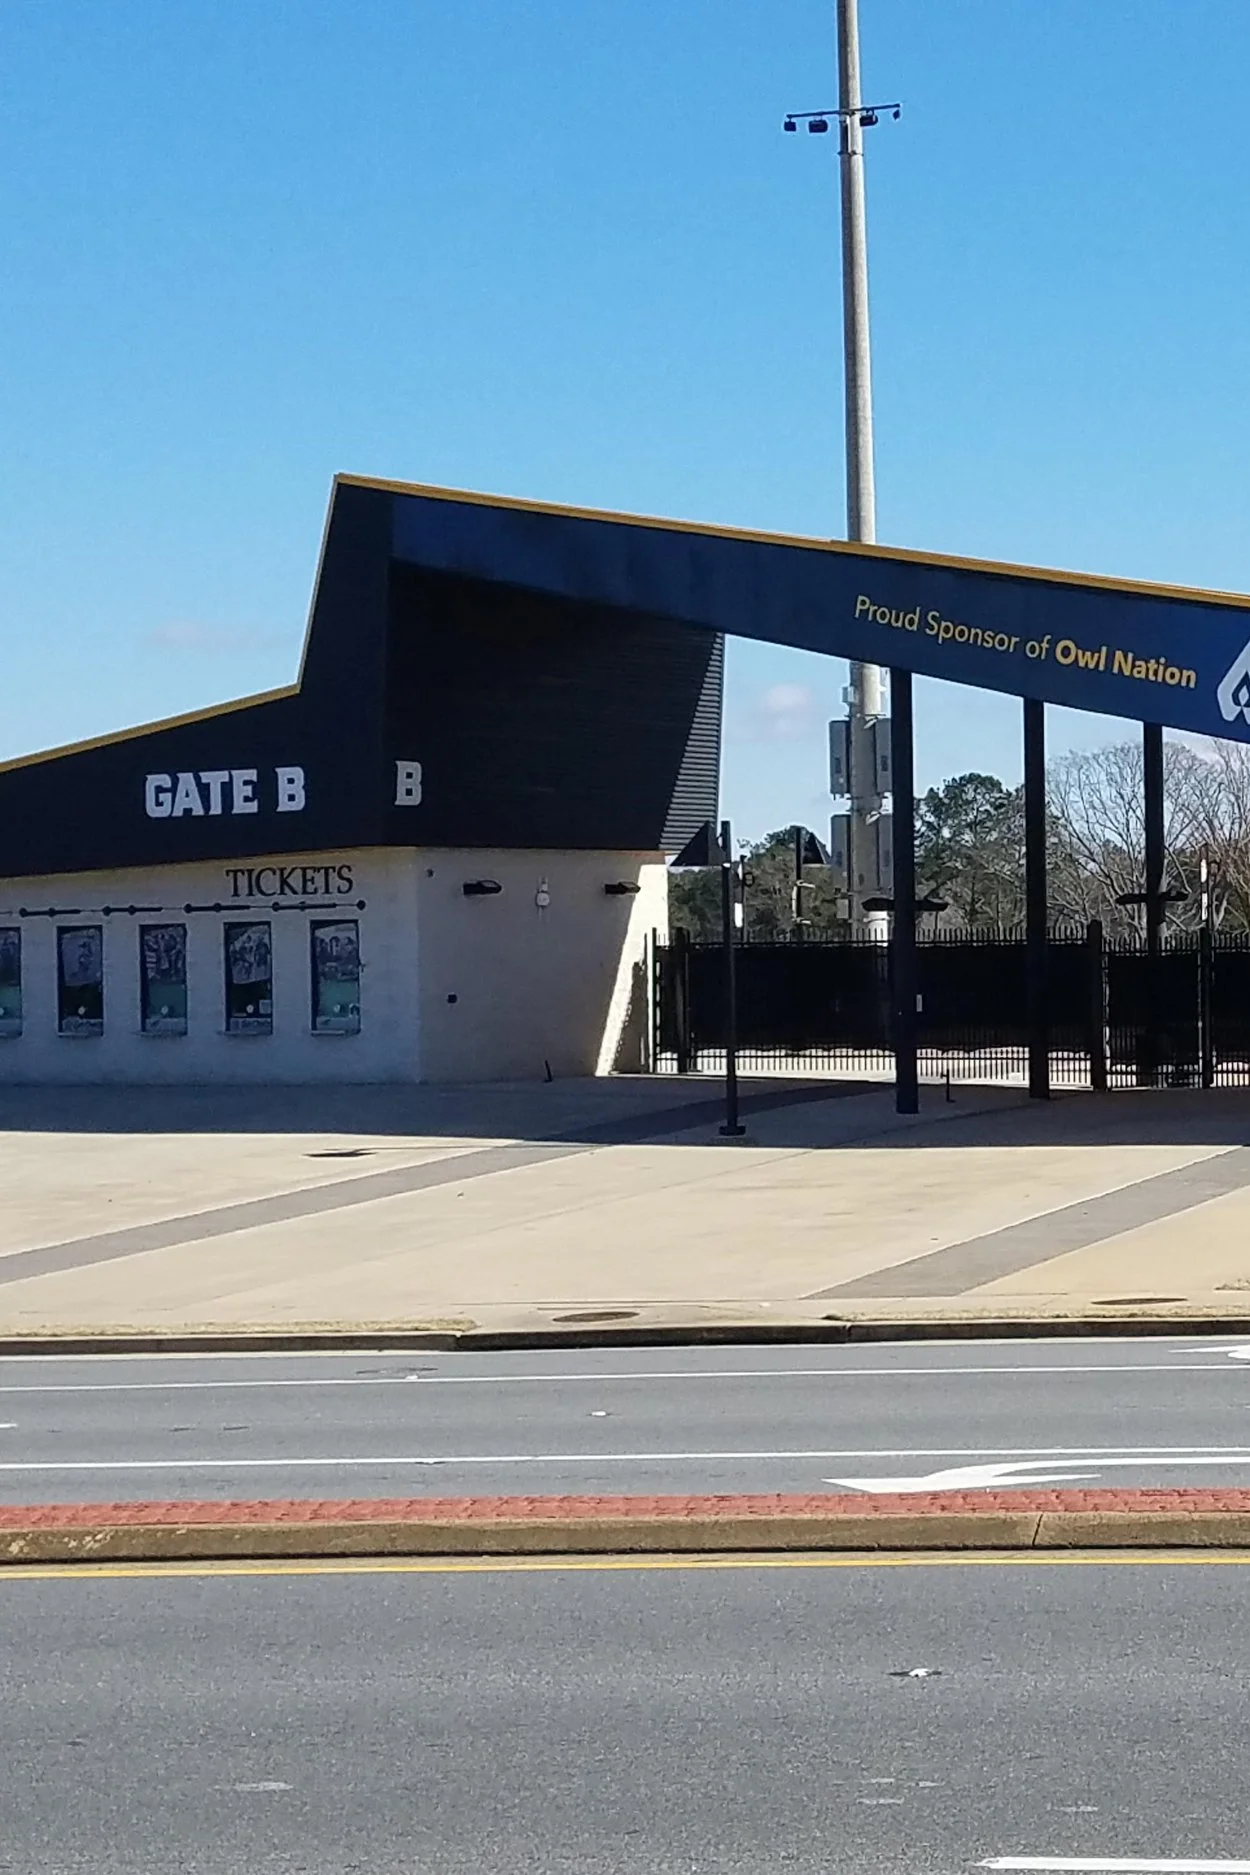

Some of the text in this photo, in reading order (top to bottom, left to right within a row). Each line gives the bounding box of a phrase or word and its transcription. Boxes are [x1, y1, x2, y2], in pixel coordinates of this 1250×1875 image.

[855, 595, 1196, 689] Proud Sponsor of Owl Nation
[145, 766, 306, 818] GATE B
[394, 760, 423, 806] B
[225, 864, 354, 897] TICKETS
